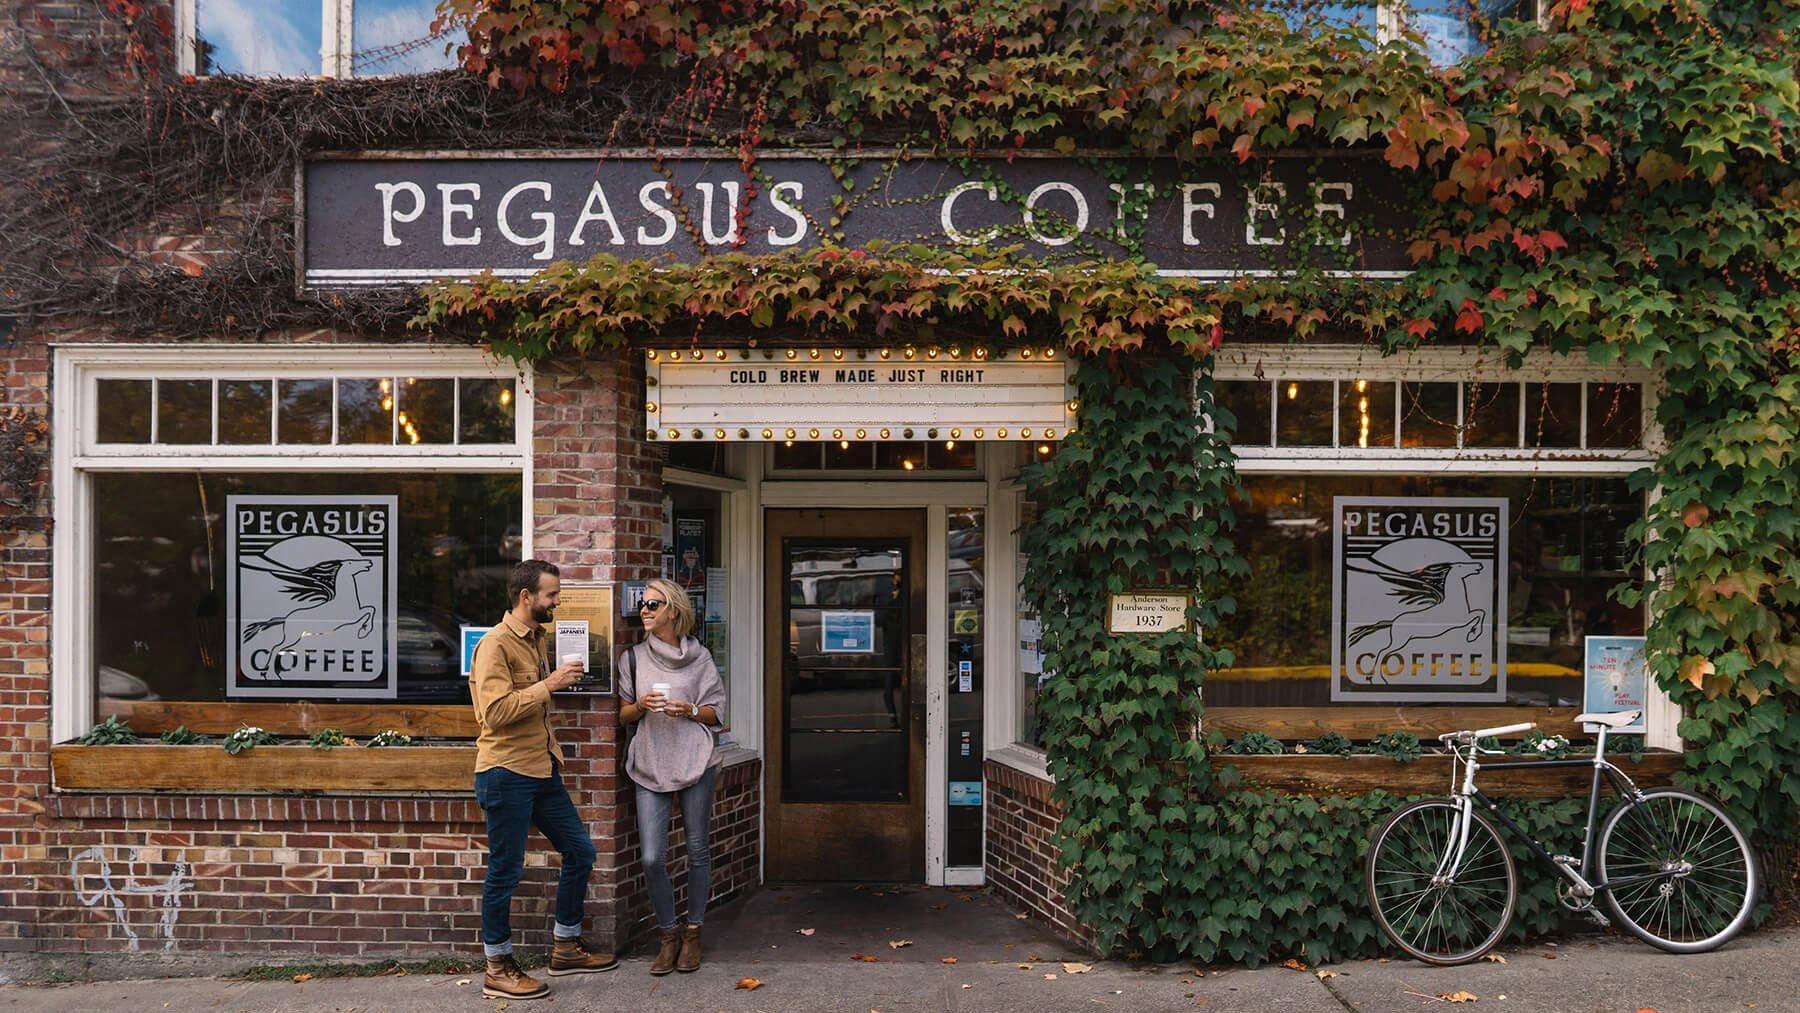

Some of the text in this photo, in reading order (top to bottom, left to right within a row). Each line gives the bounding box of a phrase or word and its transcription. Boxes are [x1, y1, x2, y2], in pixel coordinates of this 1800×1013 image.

[375, 181, 808, 260] PEGASUS
[730, 370, 985, 383] COLD BREW MADE JUST RIGHT
[239, 510, 385, 534] PEGASUS
[1345, 511, 1496, 537] PEGASUS
[1116, 603, 1181, 612] Hardware Store
[1131, 592, 1168, 603] Anderson
[1136, 615, 1163, 627] 1937
[251, 648, 374, 673] COFFEE
[1355, 652, 1483, 677] COFFEE
